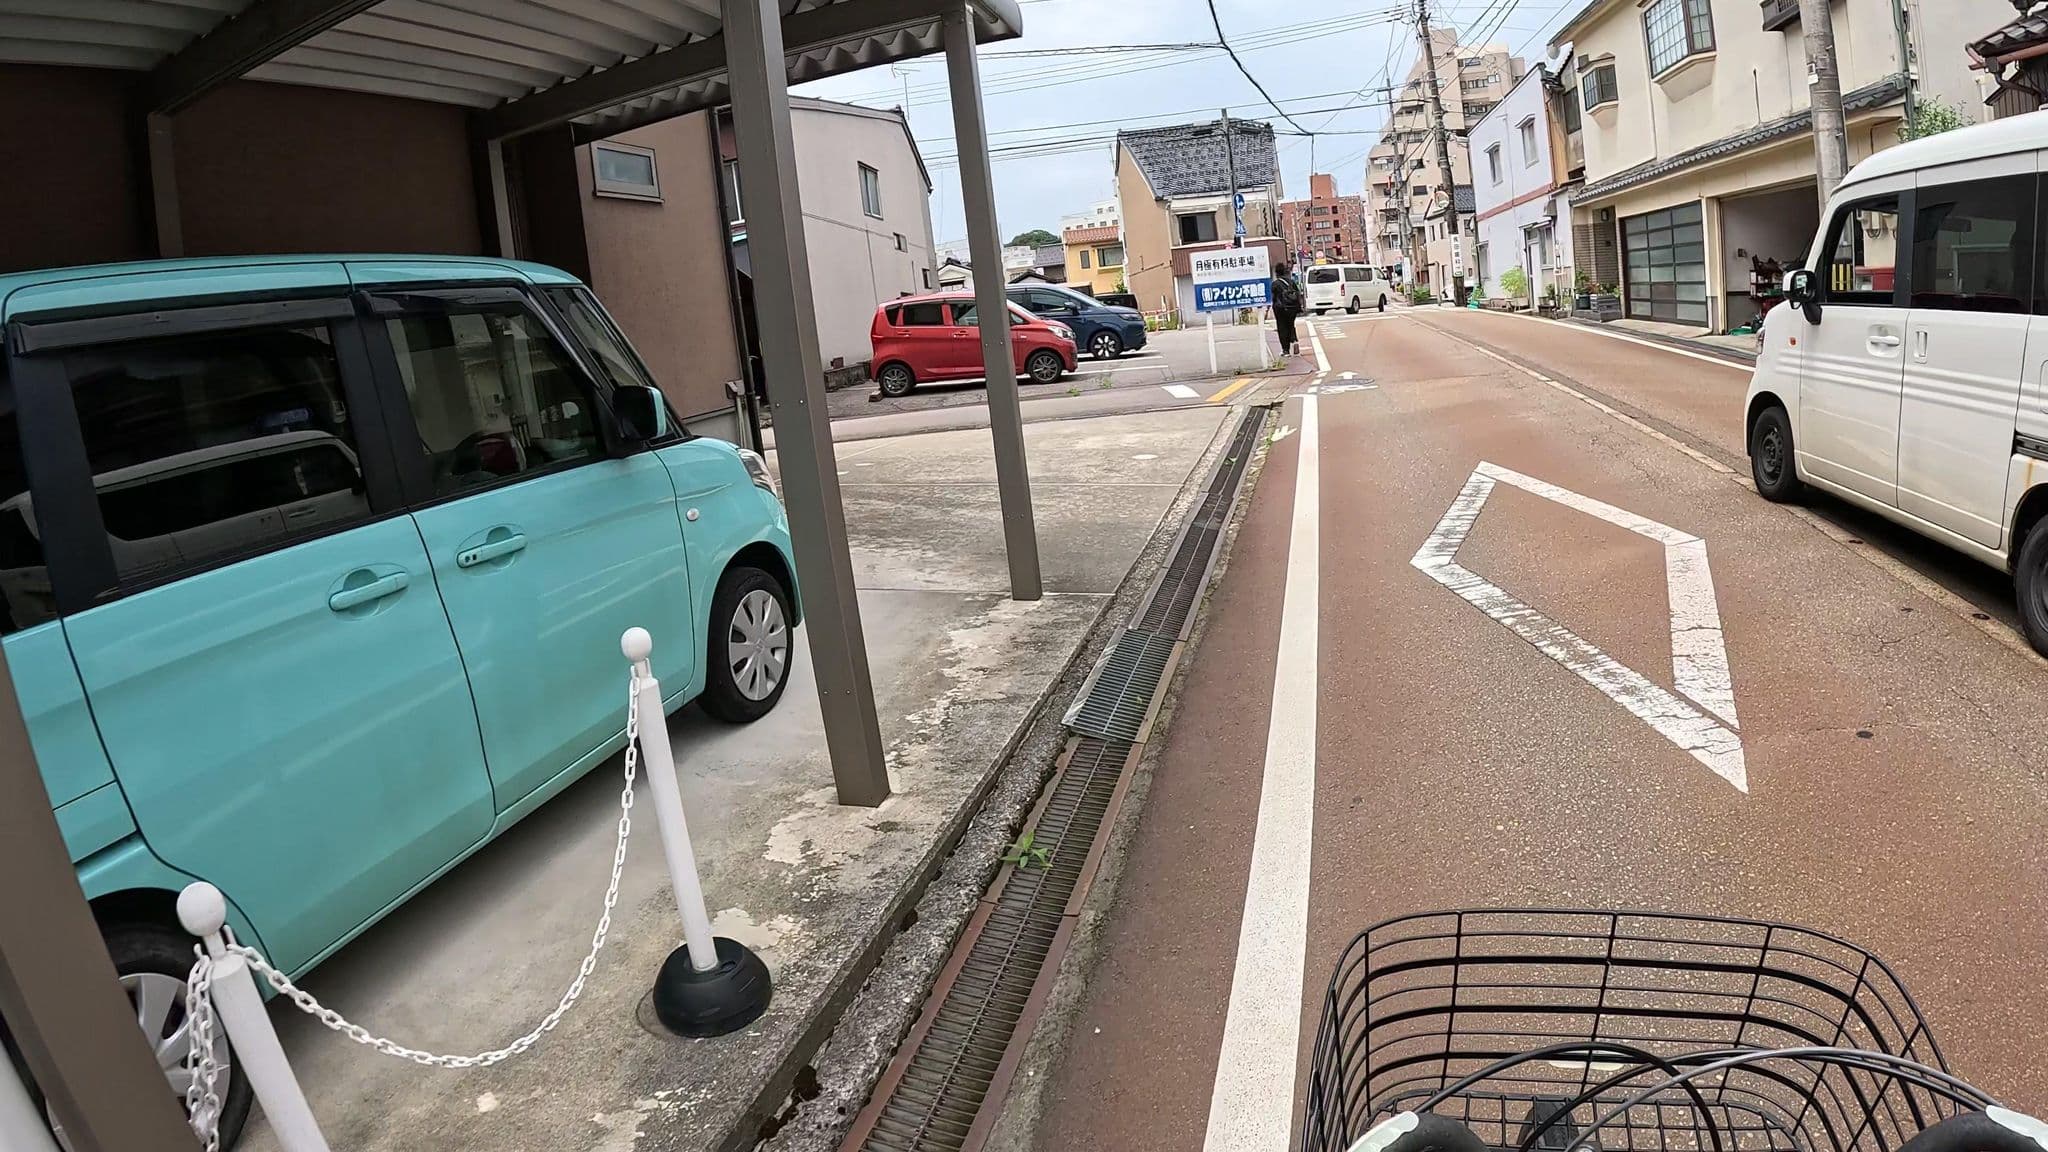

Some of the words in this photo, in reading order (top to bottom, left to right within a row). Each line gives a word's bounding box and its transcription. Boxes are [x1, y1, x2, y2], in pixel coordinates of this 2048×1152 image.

[1196, 256, 1255, 271] 月極有料駐車場
